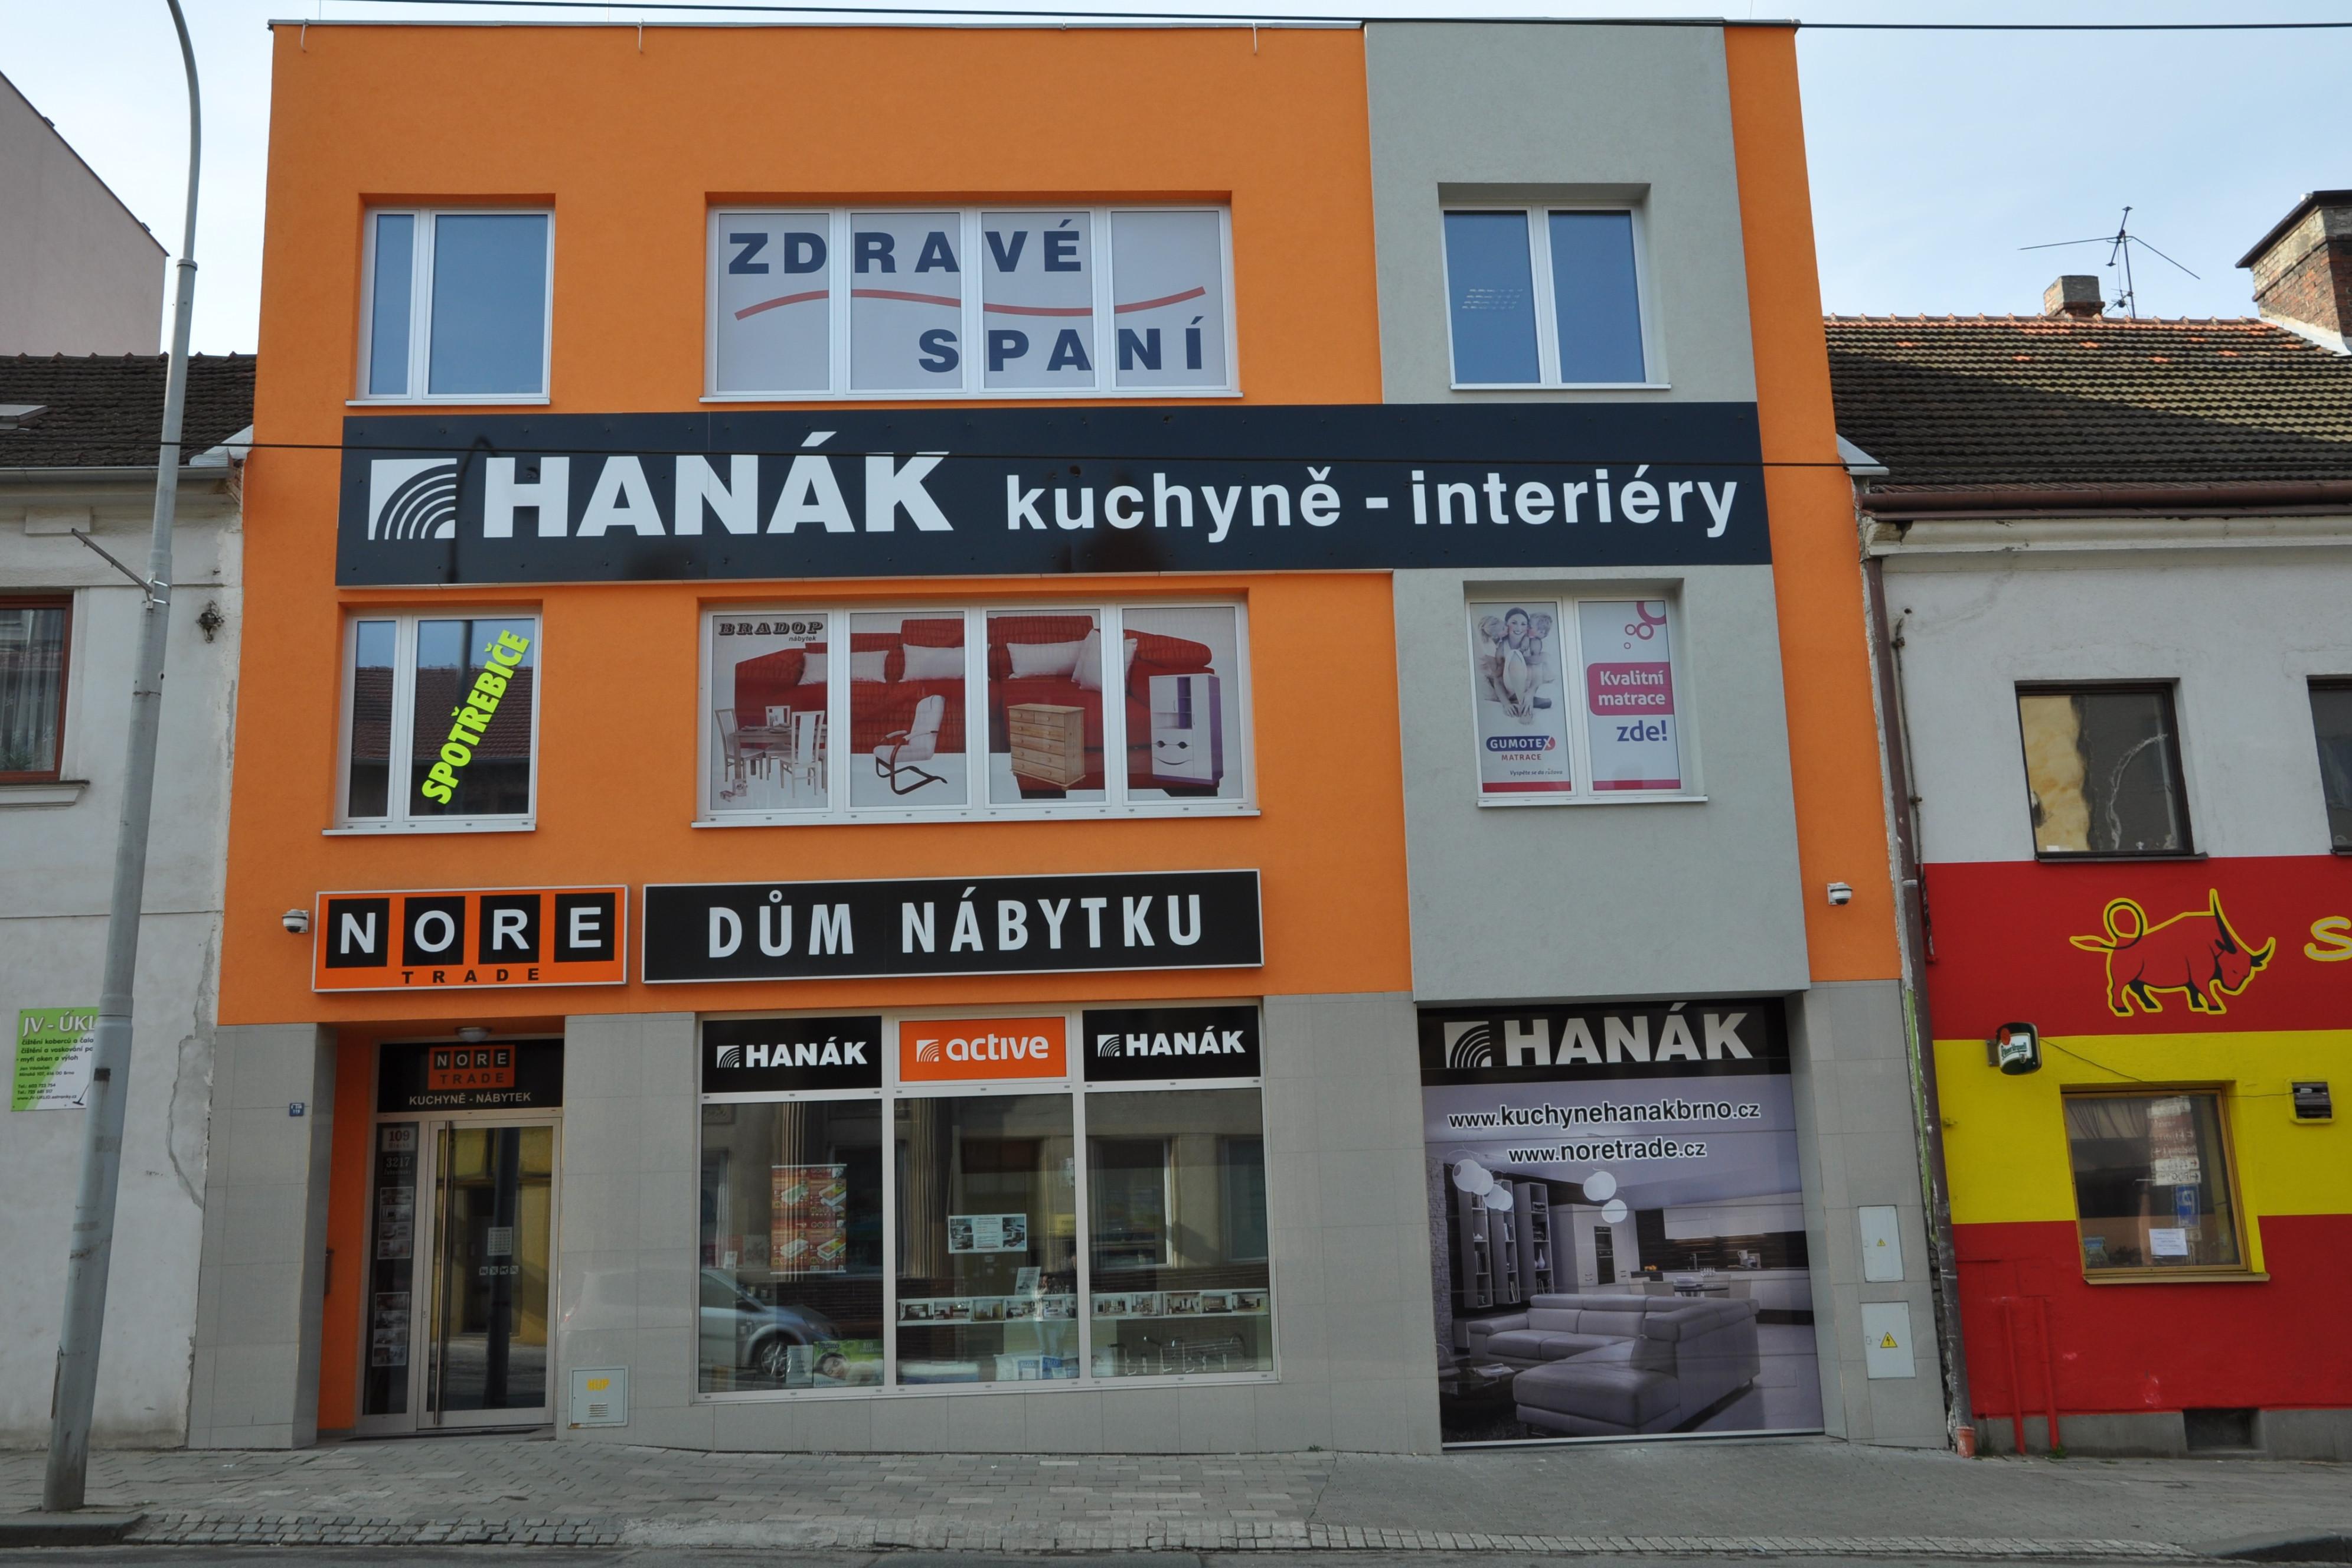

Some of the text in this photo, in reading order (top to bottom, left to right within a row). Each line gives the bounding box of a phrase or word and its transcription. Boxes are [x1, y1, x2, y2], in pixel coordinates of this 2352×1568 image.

[729, 219, 1082, 274] ZDRAVÉ
[919, 316, 1204, 373] SPANÍ
[484, 432, 1737, 543] HANÁK kuchyně - interiéry
[718, 622, 823, 635] BRADOP
[1600, 670, 1664, 686] Kvalitní
[1598, 691, 1665, 706] matrace
[422, 630, 531, 804] SPOTŘEBIČE
[1489, 737, 1552, 750] GUMOTEX
[1616, 720, 1667, 742] zde!
[340, 907, 602, 954] NORE
[708, 886, 1201, 959] DŮM NÁBYTKU
[402, 968, 539, 984] TRADE
[22, 1017, 44, 1037] JV
[1504, 1002, 1753, 1067] HANÁK
[746, 1037, 867, 1067] HANÁK
[946, 1033, 1048, 1061] active
[1126, 1025, 1246, 1057] HANÁK
[437, 1053, 506, 1066] NORE
[440, 1073, 504, 1084] TRADE
[409, 1093, 466, 1106] KUCHYNĚ
[476, 1092, 531, 1104] NÁBYTEK
[1448, 1098, 1761, 1131] www.kuchynehanakbrno.cz
[389, 1130, 410, 1142] 109
[386, 1157, 411, 1168] 3217
[1508, 1136, 1706, 1164] www.noretrade.cz
